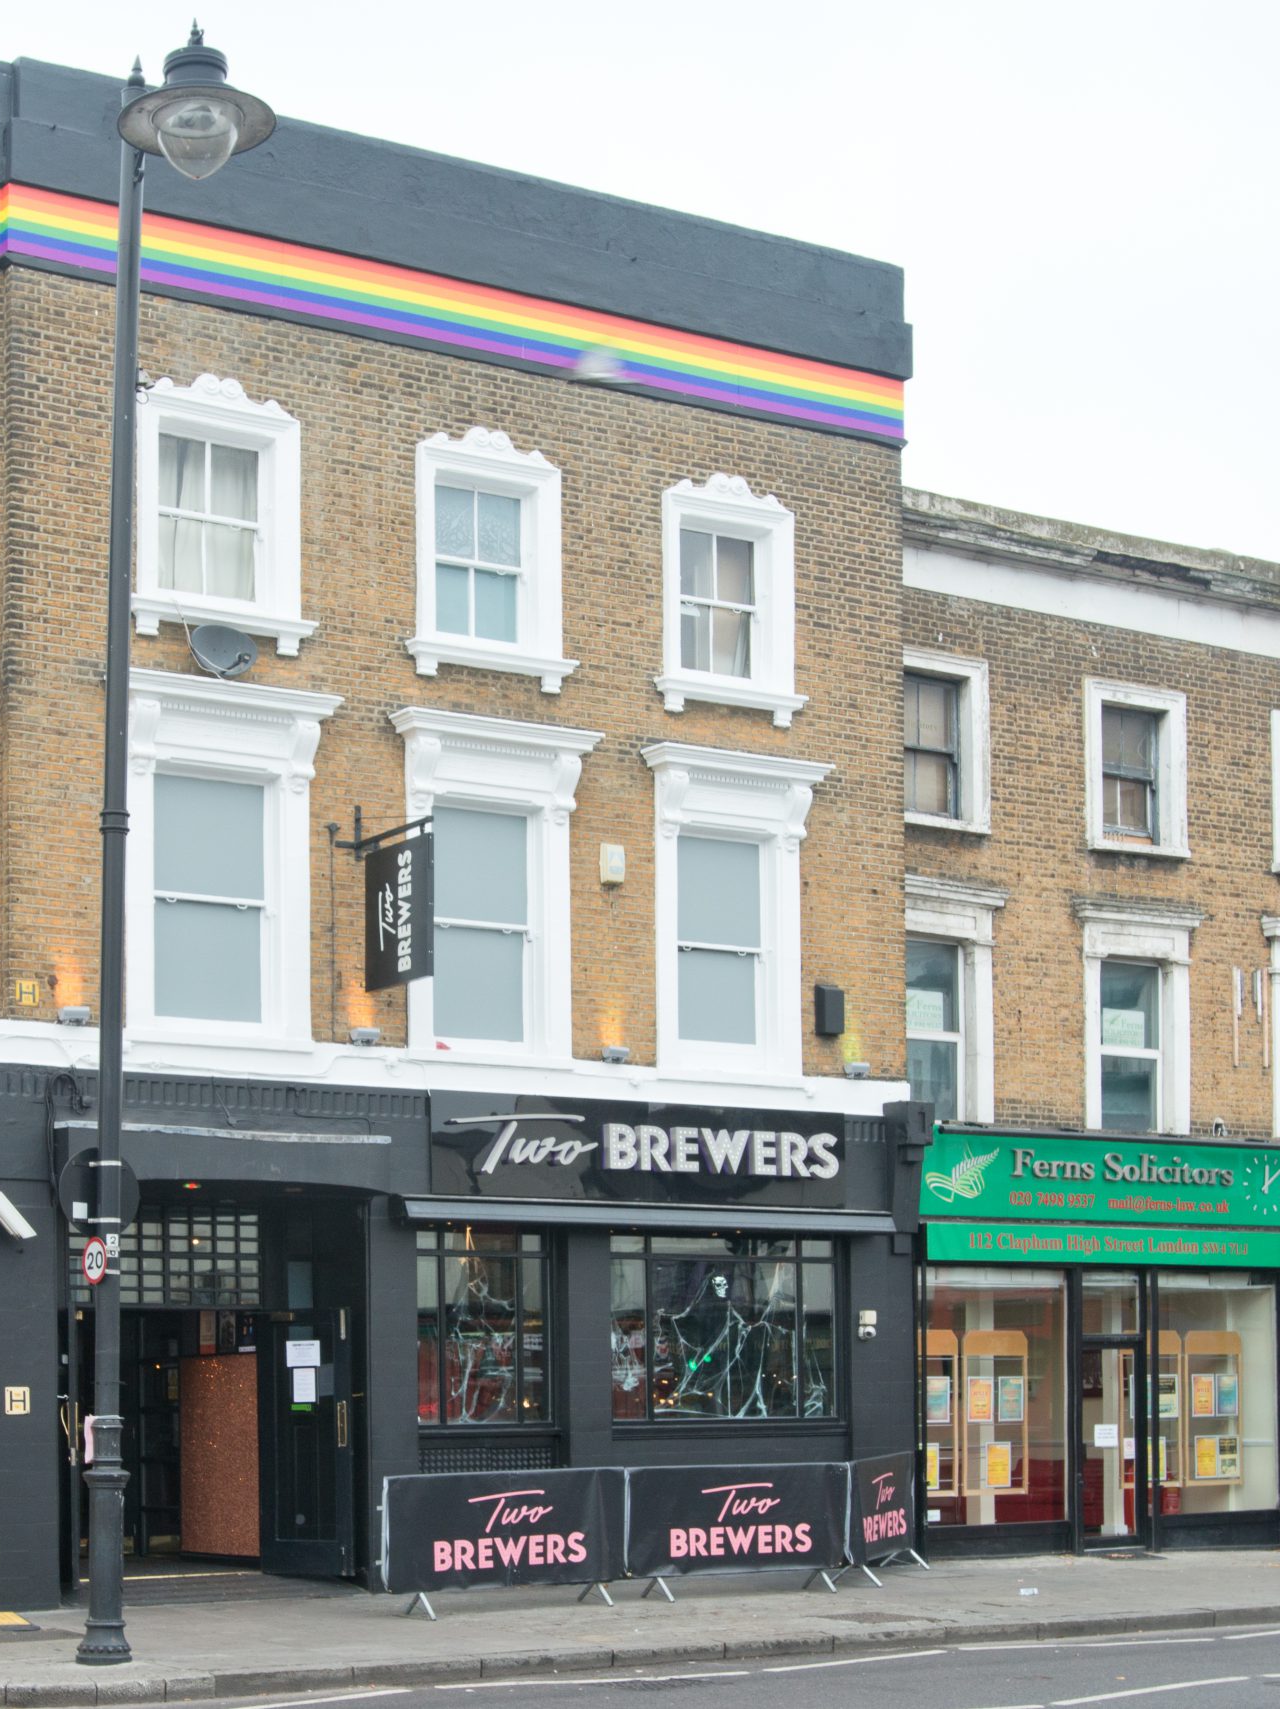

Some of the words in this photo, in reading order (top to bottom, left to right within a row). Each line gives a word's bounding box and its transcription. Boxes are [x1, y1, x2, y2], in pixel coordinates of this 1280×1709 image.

[378, 882, 396, 952] Two
[397, 850, 412, 973] BREWERS
[18, 982, 36, 1004] H
[444, 1113, 599, 1174] Two
[602, 1122, 840, 1180] BREWERS
[1011, 1148, 1096, 1181] Ferns
[1103, 1152, 1234, 1187] Solicitors
[1009, 1191, 1032, 1207] 020
[1036, 1192, 1064, 1208] 7498
[1067, 1193, 1095, 1209] 9537
[87, 1250, 103, 1270] 20
[969, 1232, 993, 1249] 112
[996, 1232, 1062, 1254] Clapham
[1067, 1234, 1100, 1255] High
[1103, 1236, 1144, 1253] Street
[1147, 1237, 1199, 1254] London
[1202, 1241, 1226, 1255] SW4
[9, 1390, 26, 1411] H
[701, 1482, 780, 1523] Two
[872, 1472, 895, 1510] Two
[468, 1489, 553, 1533] Two
[863, 1508, 907, 1544] BREWERS
[433, 1531, 587, 1572] BREWERS
[670, 1523, 813, 1558] BREWERS
